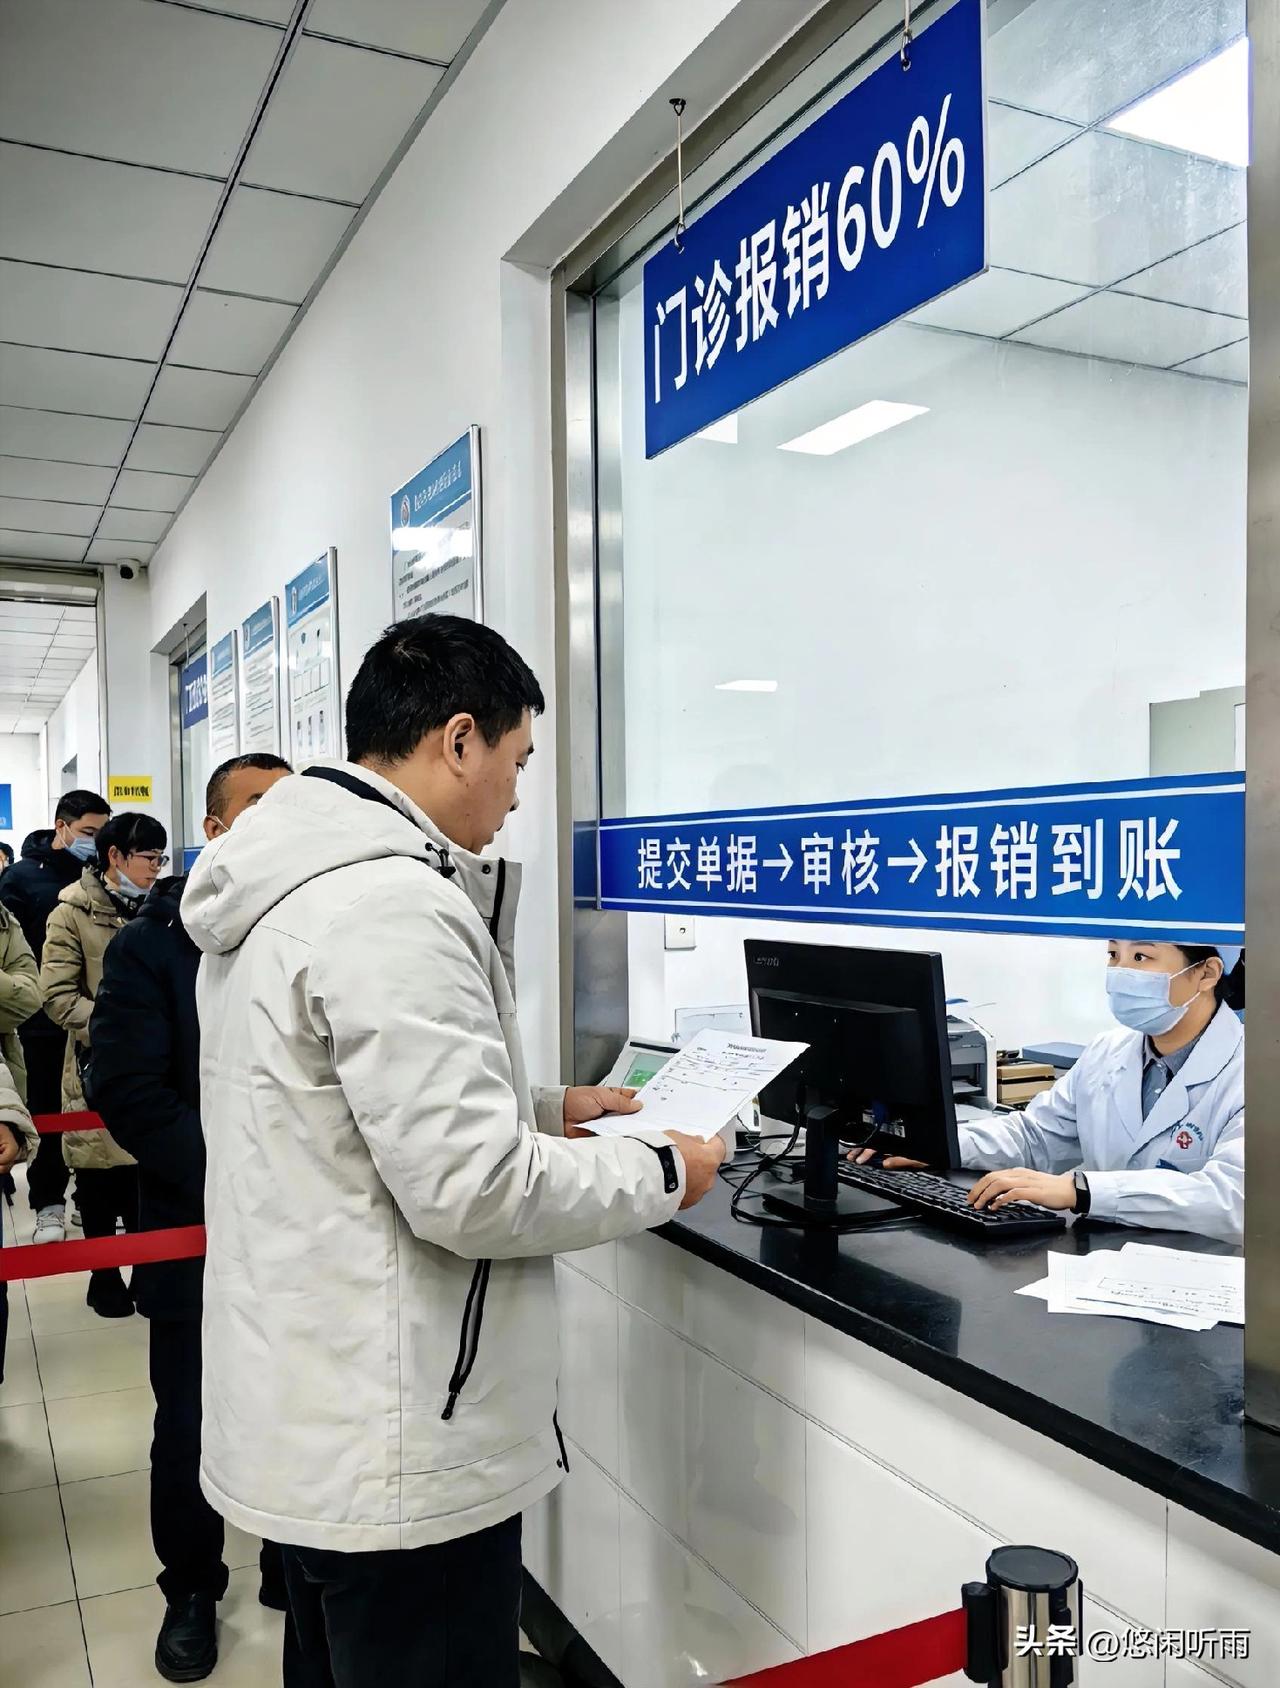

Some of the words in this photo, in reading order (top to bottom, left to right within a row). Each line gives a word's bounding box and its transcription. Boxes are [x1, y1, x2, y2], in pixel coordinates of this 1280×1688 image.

[654, 93, 965, 404] 门诊报销60%
[637, 834, 758, 893] 提交单据
[800, 830, 881, 896] 审核
[935, 817, 1183, 901] 报销到账
